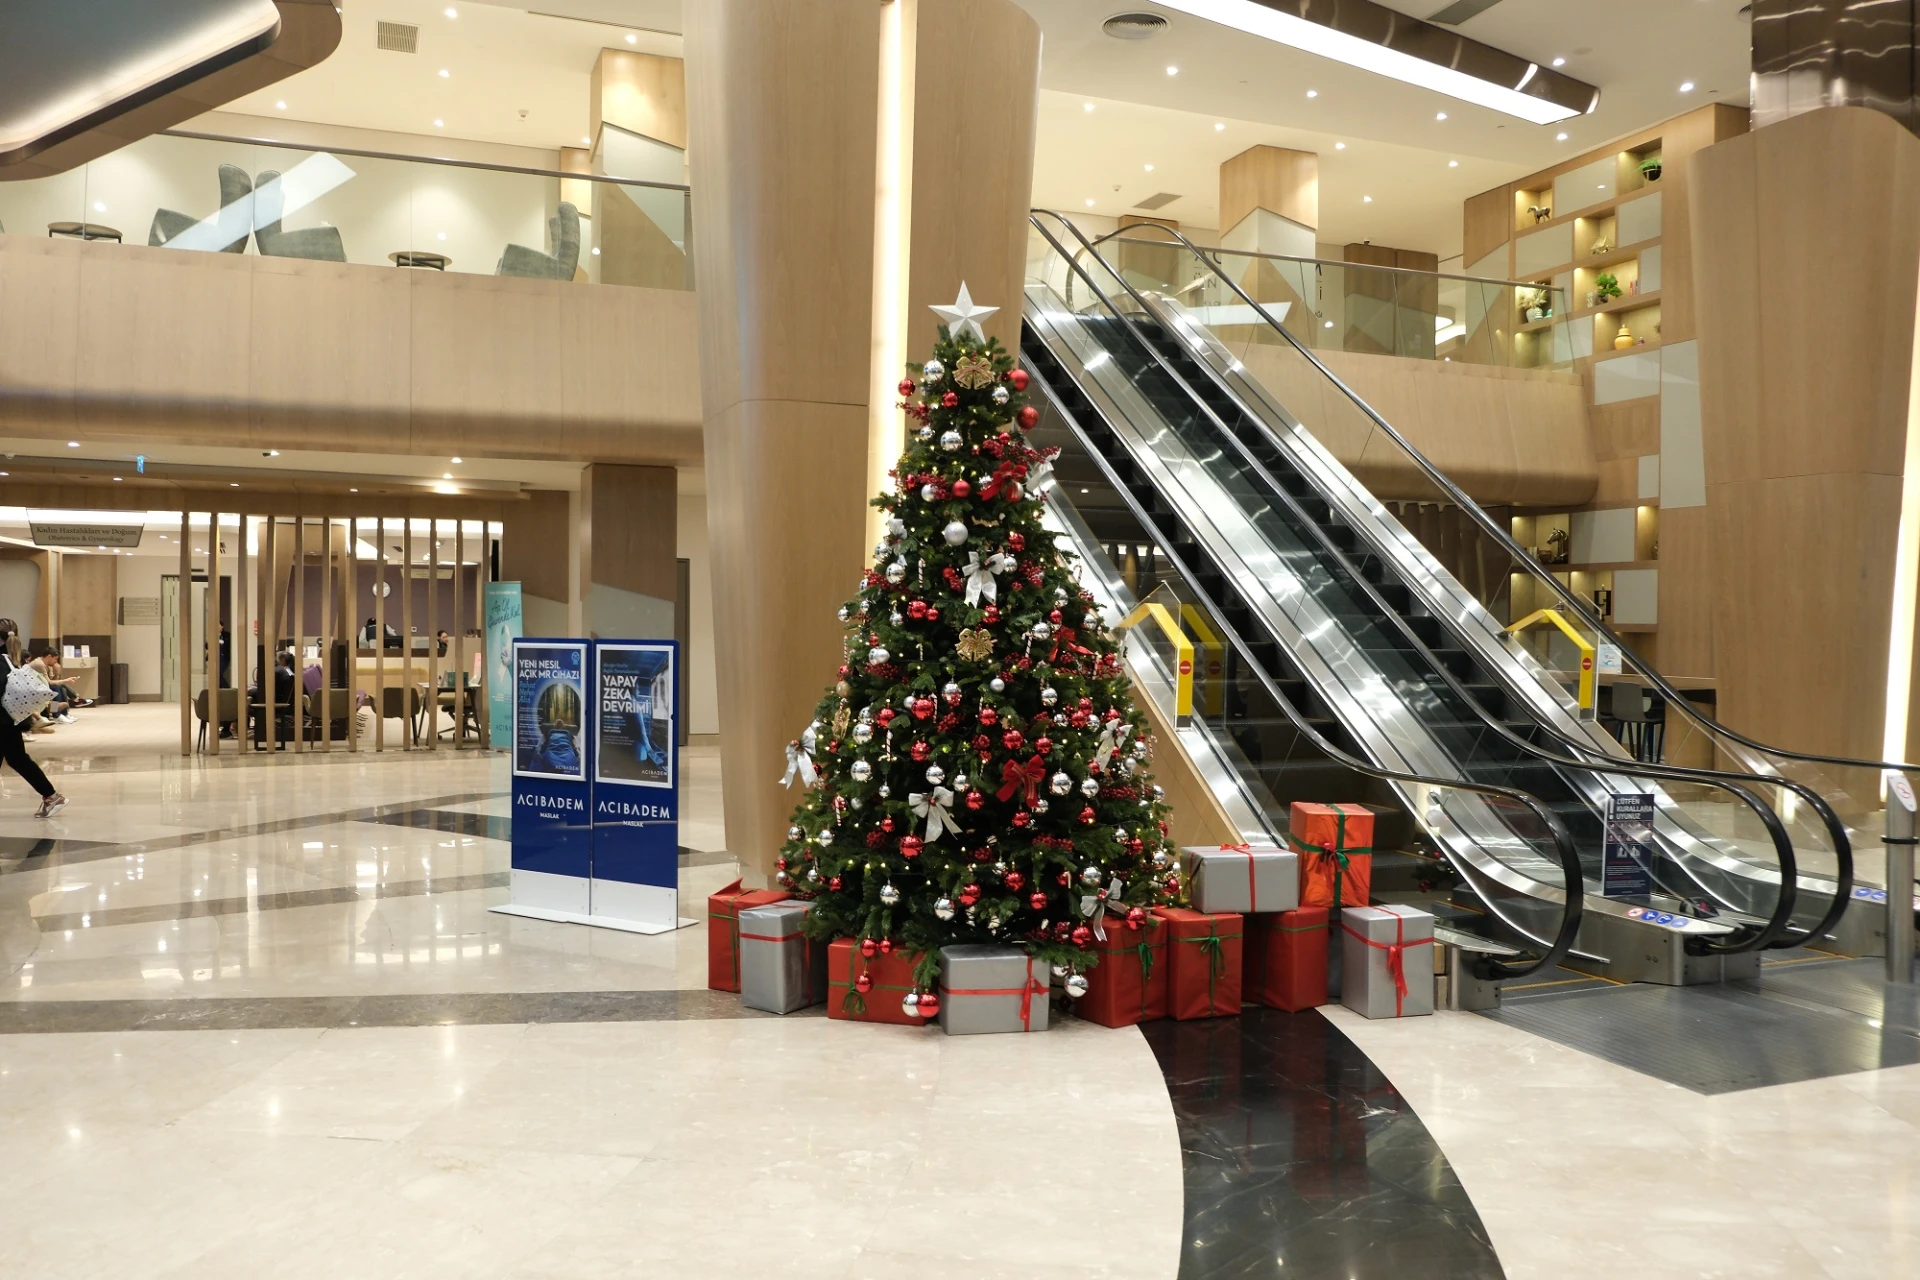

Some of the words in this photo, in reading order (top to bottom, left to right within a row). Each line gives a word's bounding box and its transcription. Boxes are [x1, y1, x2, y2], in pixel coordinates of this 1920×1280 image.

[36, 526, 58, 534] Kadın
[59, 527, 101, 535] Hastalıkları
[111, 528, 138, 537] Doğum
[538, 659, 561, 669] NESİL
[519, 669, 538, 681] AÇIK
[538, 669, 551, 679] MR
[603, 674, 638, 688] YAPAY
[603, 687, 632, 700] ZEKA
[603, 699, 649, 714] DEVRİMİ
[517, 793, 584, 811] ACIBADEM
[1616, 796, 1641, 805] LÜTFEN
[598, 800, 670, 819] ACIBADEM
[1616, 812, 1641, 820] UYUNUZ
[622, 819, 644, 828] MASLAK
